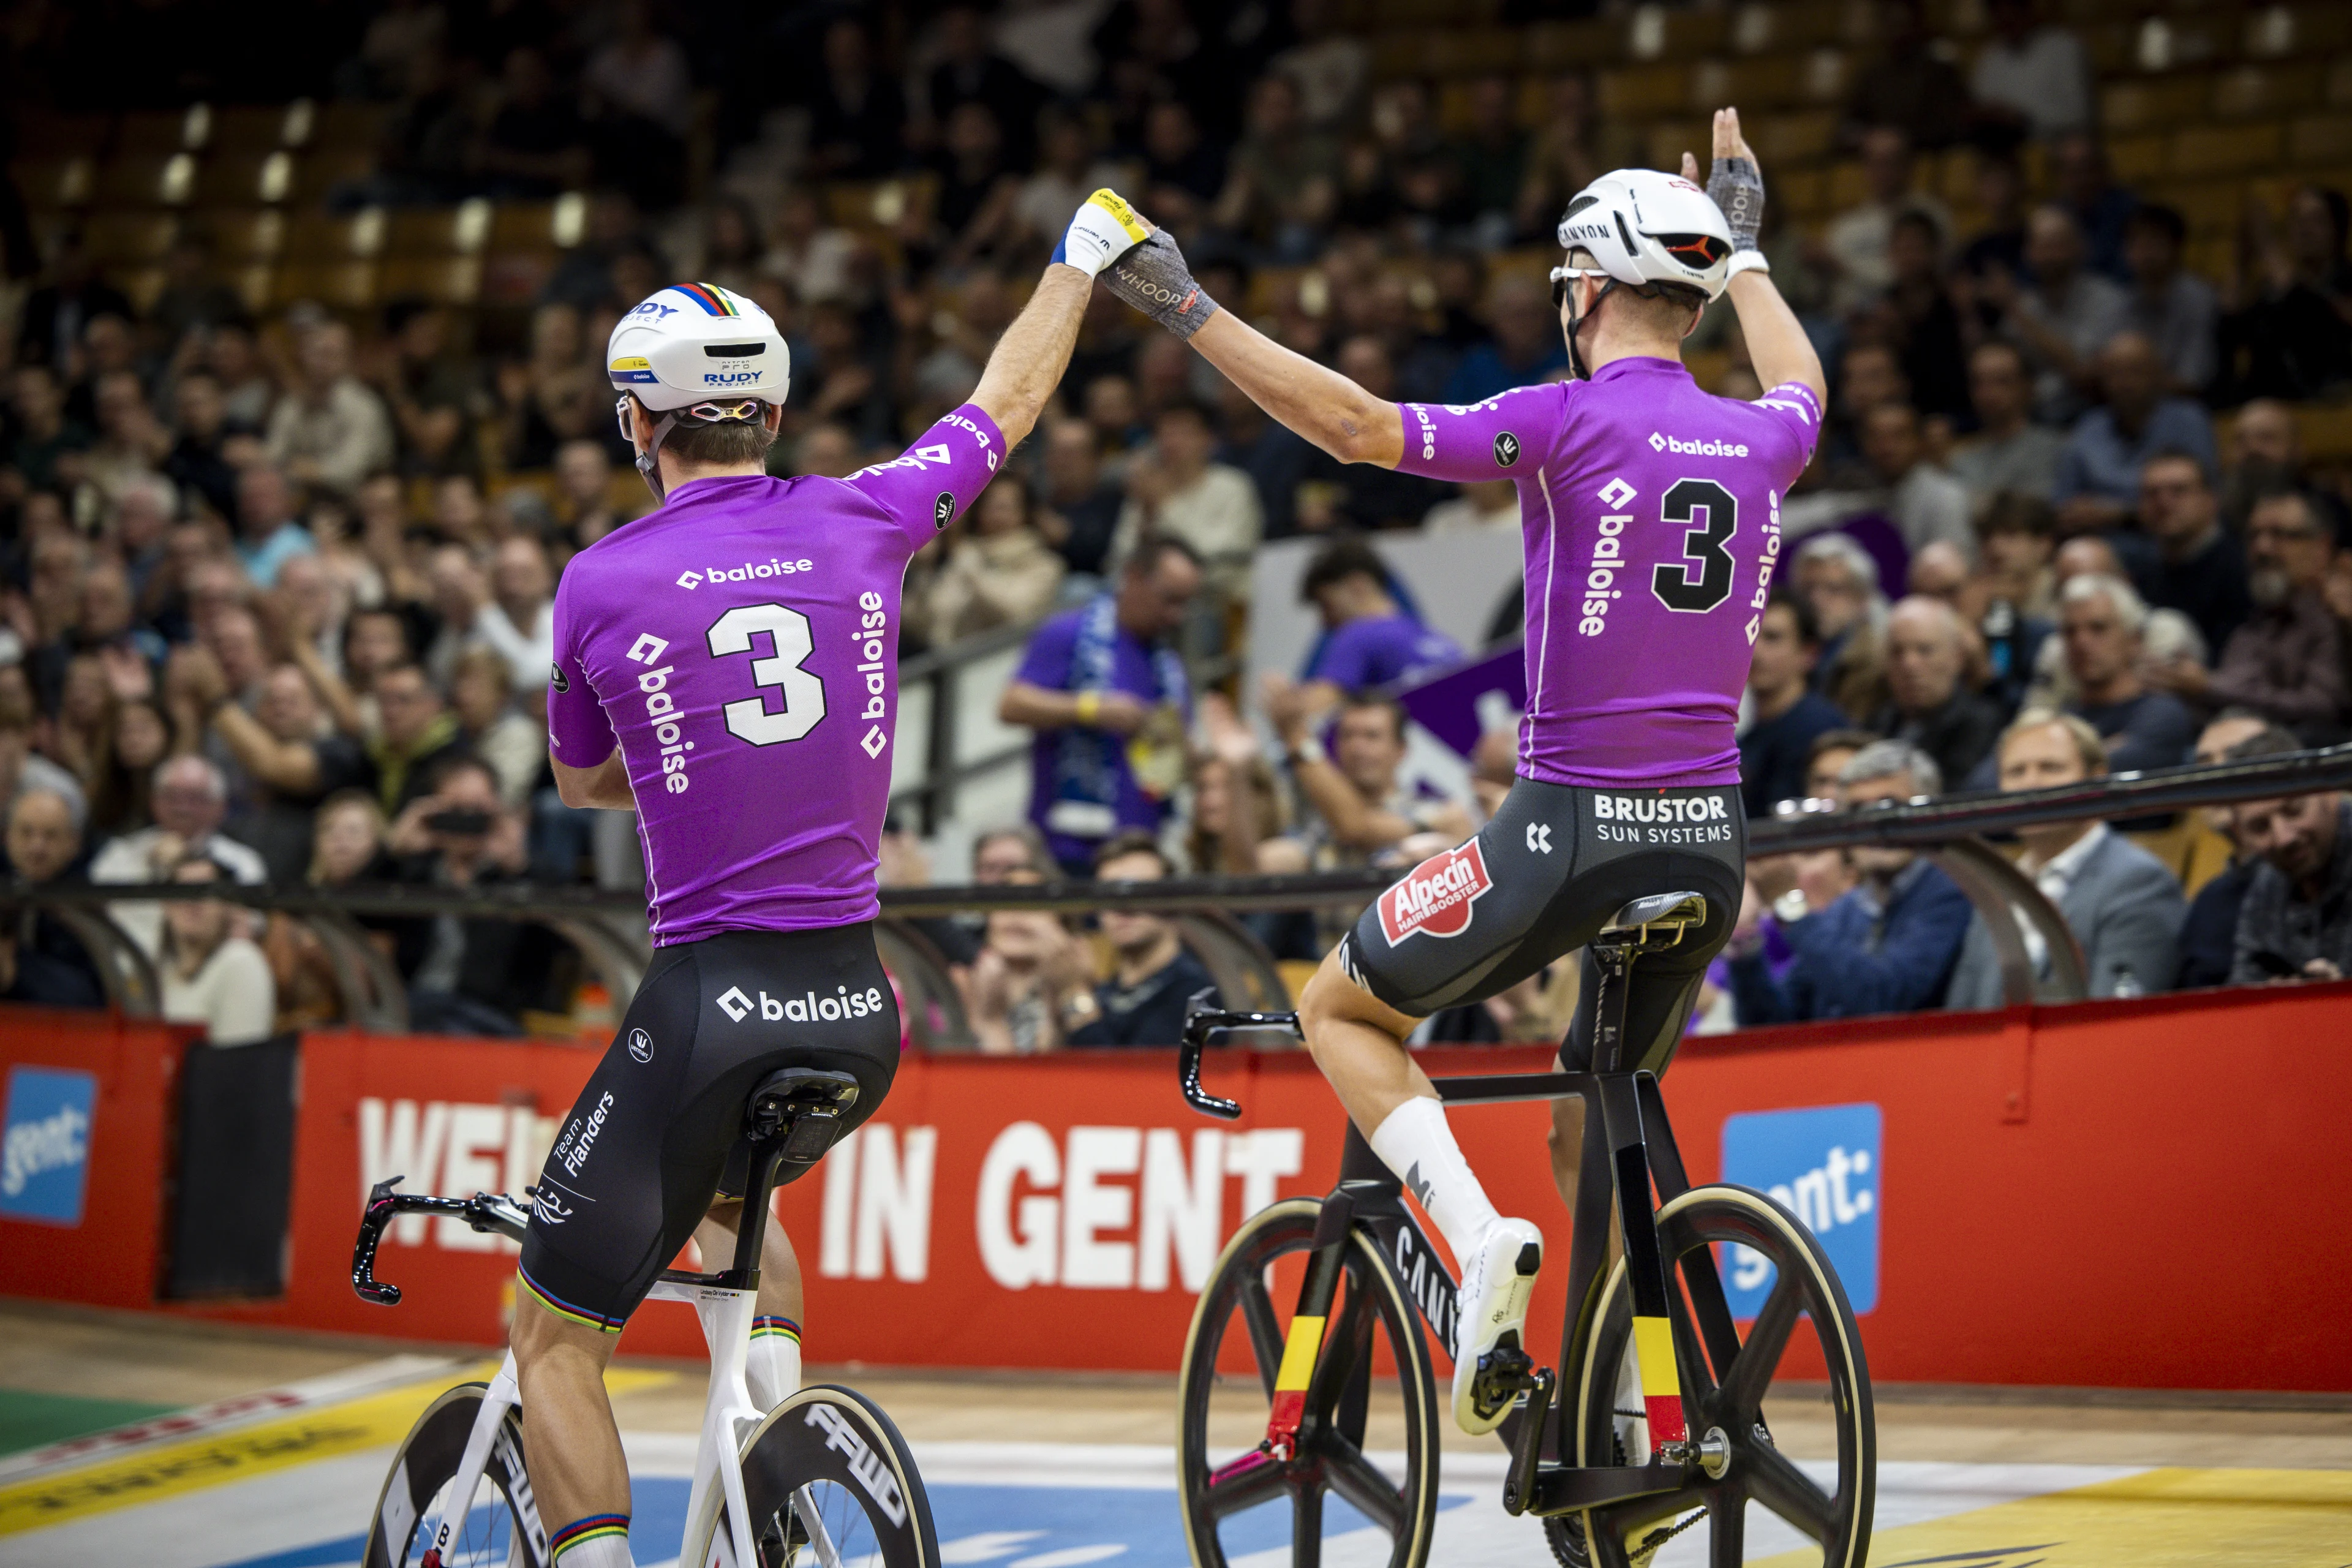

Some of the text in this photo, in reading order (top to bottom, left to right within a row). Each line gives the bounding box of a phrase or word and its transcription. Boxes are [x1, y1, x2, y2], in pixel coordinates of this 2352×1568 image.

[1559, 225, 1610, 243] CANYON
[1115, 265, 1182, 307] WHOOP
[704, 371, 763, 383] RUDY
[1668, 435, 1749, 457] baloise
[942, 499, 954, 526] vermarc
[1651, 477, 1738, 614] 3
[1751, 489, 1781, 609] baloise
[706, 558, 813, 584] baloise
[1578, 514, 1634, 637] baloise
[705, 601, 827, 748] 3
[851, 590, 886, 720] baloise
[638, 665, 688, 794] baloise
[1594, 794, 1728, 823] BRUSTOR
[1597, 824, 1732, 843] SUN SYSTEMS
[1393, 855, 1477, 921] Alpecin
[1396, 880, 1480, 933] HAIR BOOSTER
[760, 986, 883, 1022] baloise
[630, 1045, 649, 1060] vermarc
[552, 1116, 582, 1161] Team
[564, 1090, 614, 1178] Flanders
[819, 1121, 938, 1283] IN
[977, 1120, 1305, 1294] GENT
